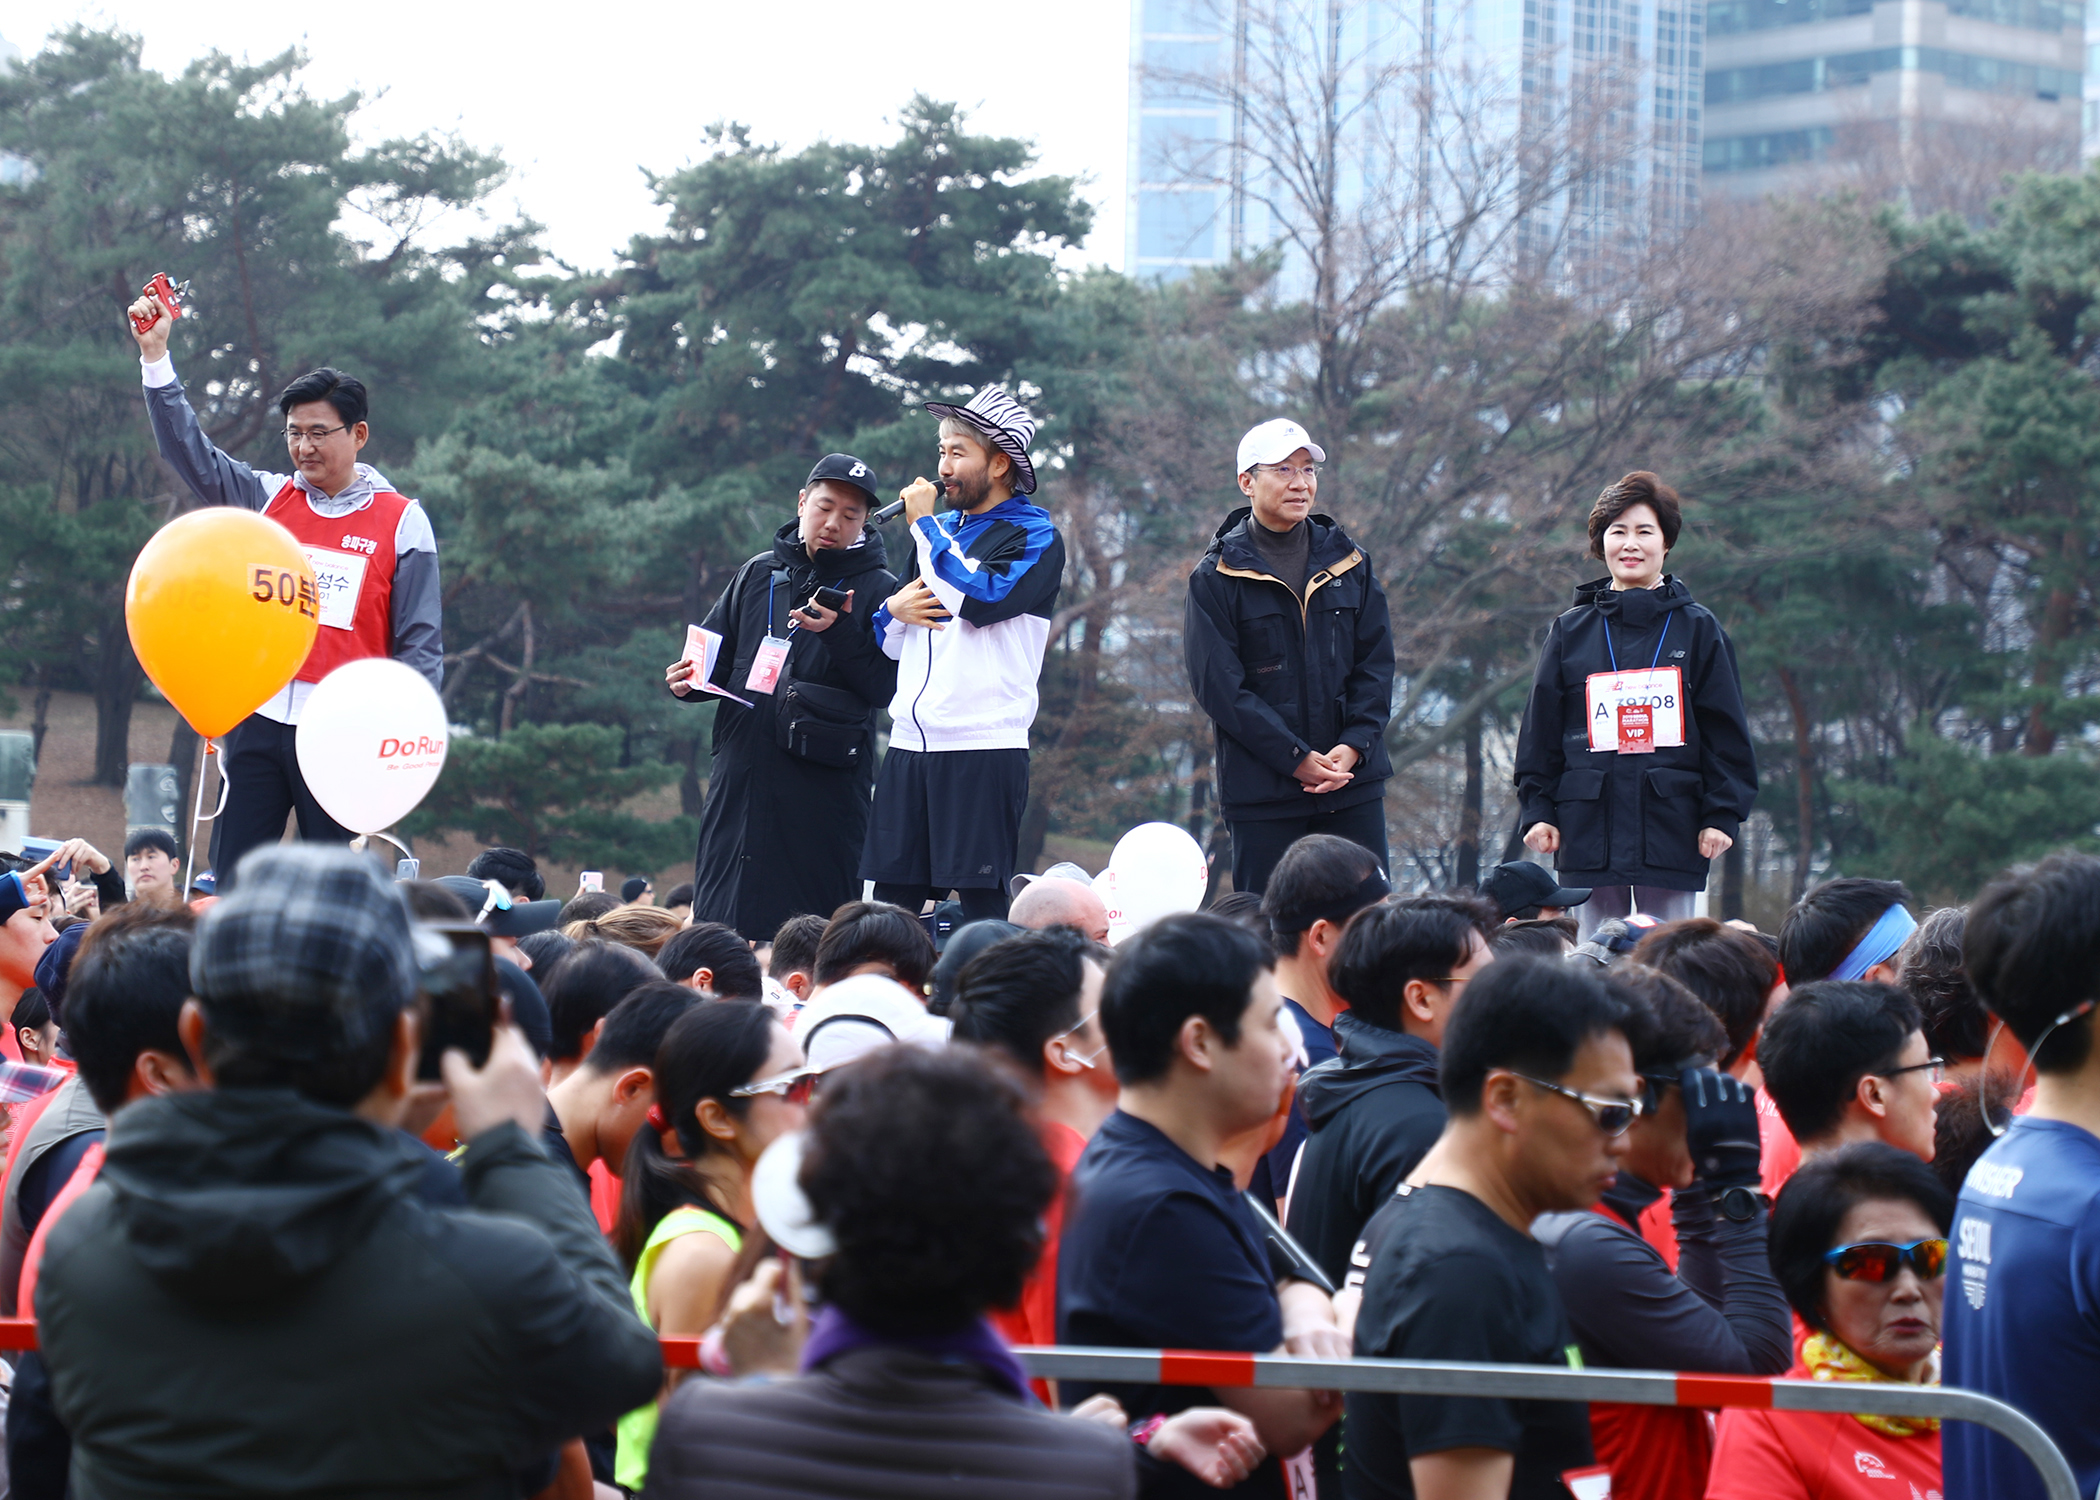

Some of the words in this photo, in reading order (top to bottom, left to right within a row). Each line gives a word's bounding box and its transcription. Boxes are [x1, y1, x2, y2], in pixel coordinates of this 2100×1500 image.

[848, 461, 867, 478] B
[341, 534, 378, 555] 송파구청
[314, 571, 350, 592] 성수
[252, 568, 318, 619] 50분
[1667, 650, 1686, 659] NB
[1594, 702, 1610, 719] A
[1626, 728, 1645, 738] VIP
